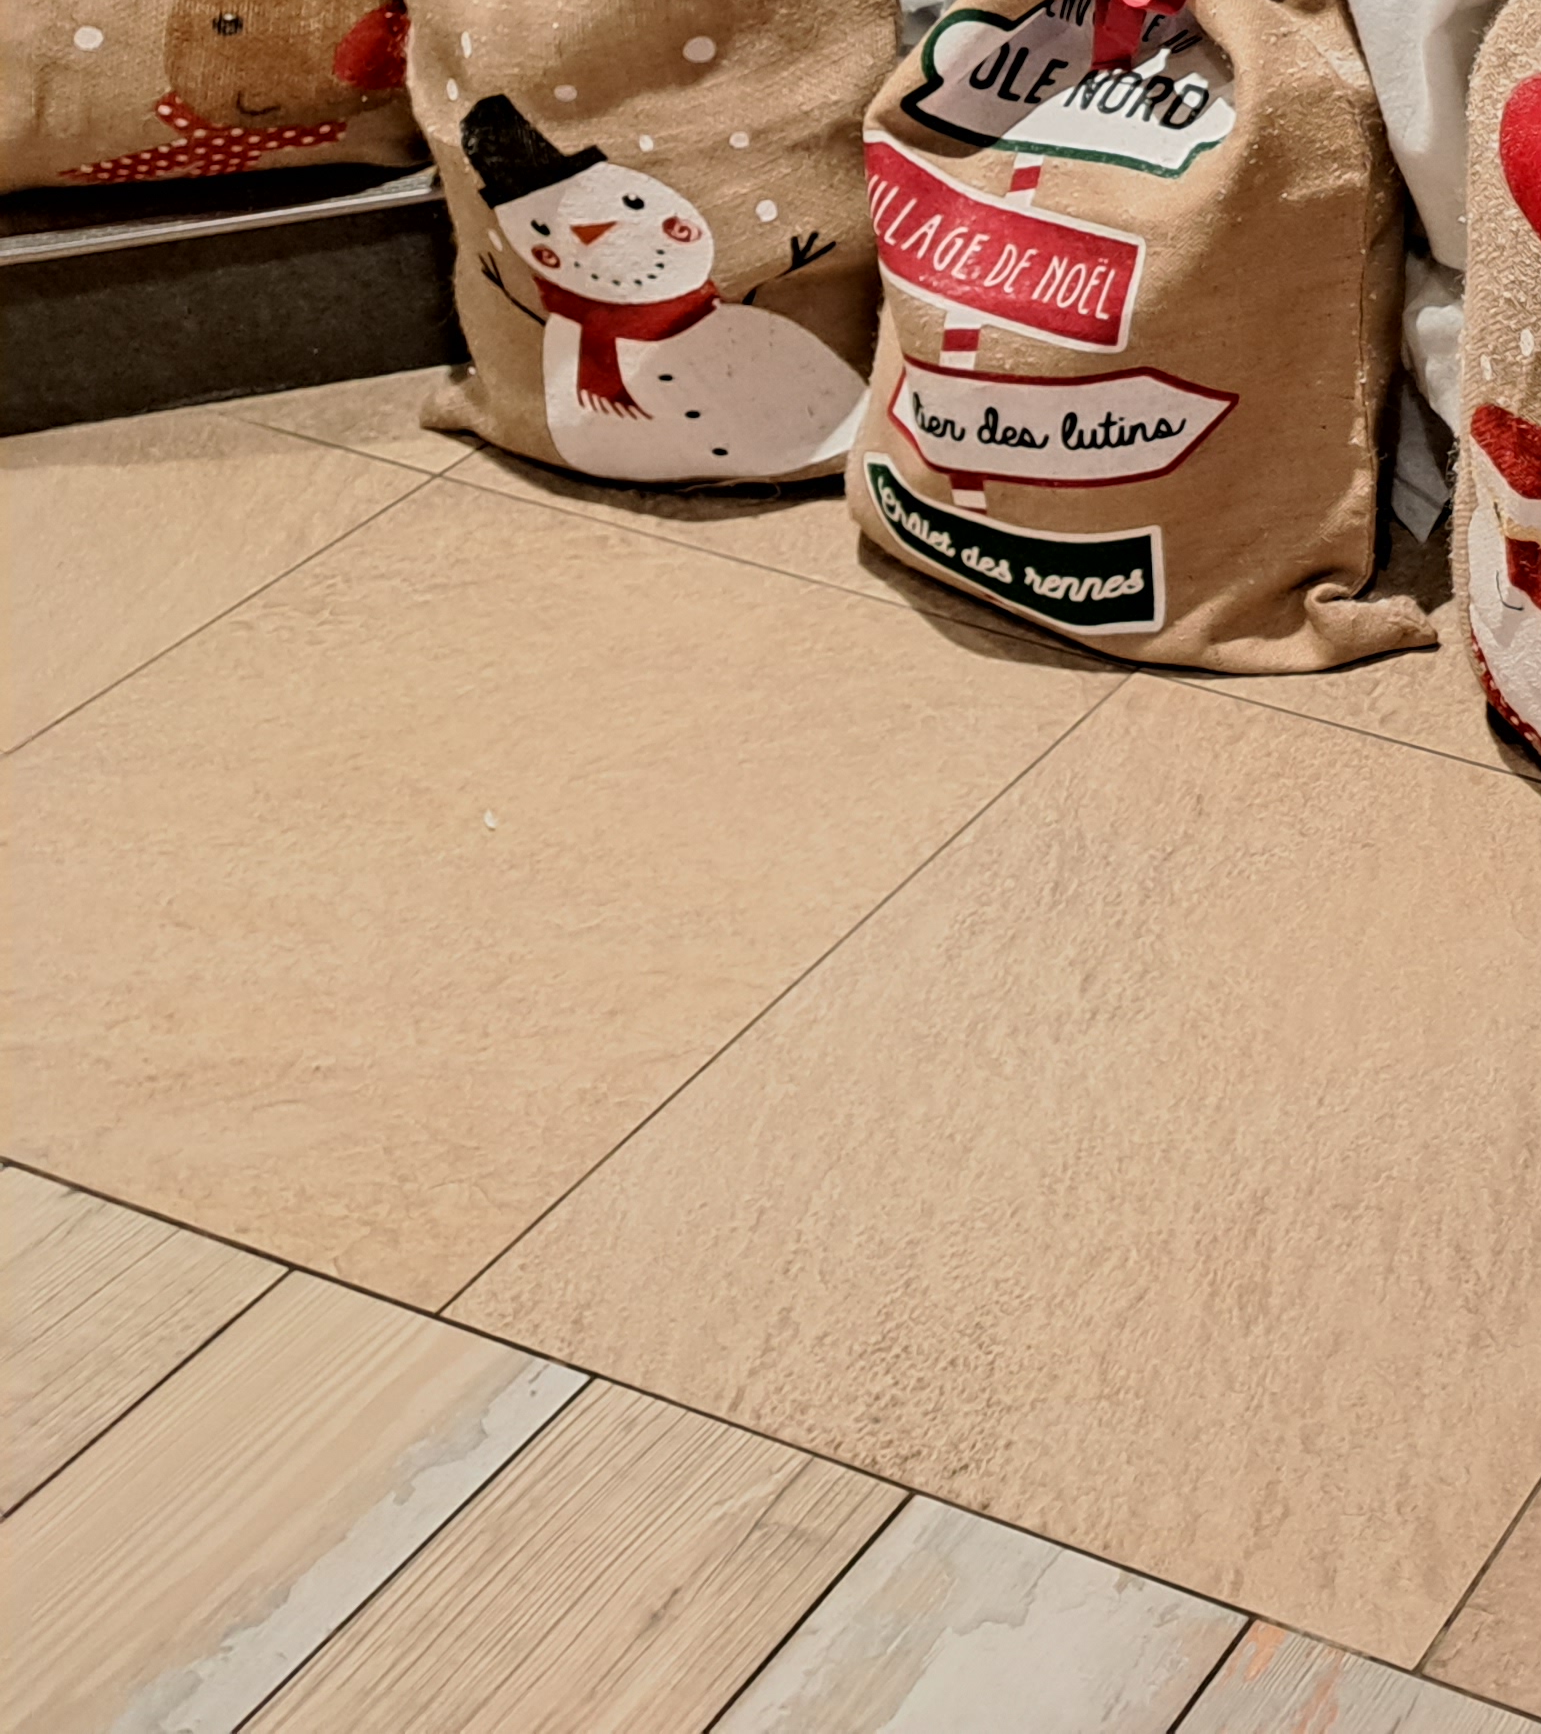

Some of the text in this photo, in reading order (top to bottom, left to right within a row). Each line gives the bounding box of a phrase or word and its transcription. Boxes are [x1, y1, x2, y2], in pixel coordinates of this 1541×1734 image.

[969, 42, 1210, 130] OLE NORD
[983, 242, 1039, 294] DE
[1031, 254, 1116, 321] NOËL
[977, 406, 1050, 450] des
[1061, 411, 1187, 450] lutins
[960, 546, 1014, 584] des
[1023, 566, 1146, 603] rennes
